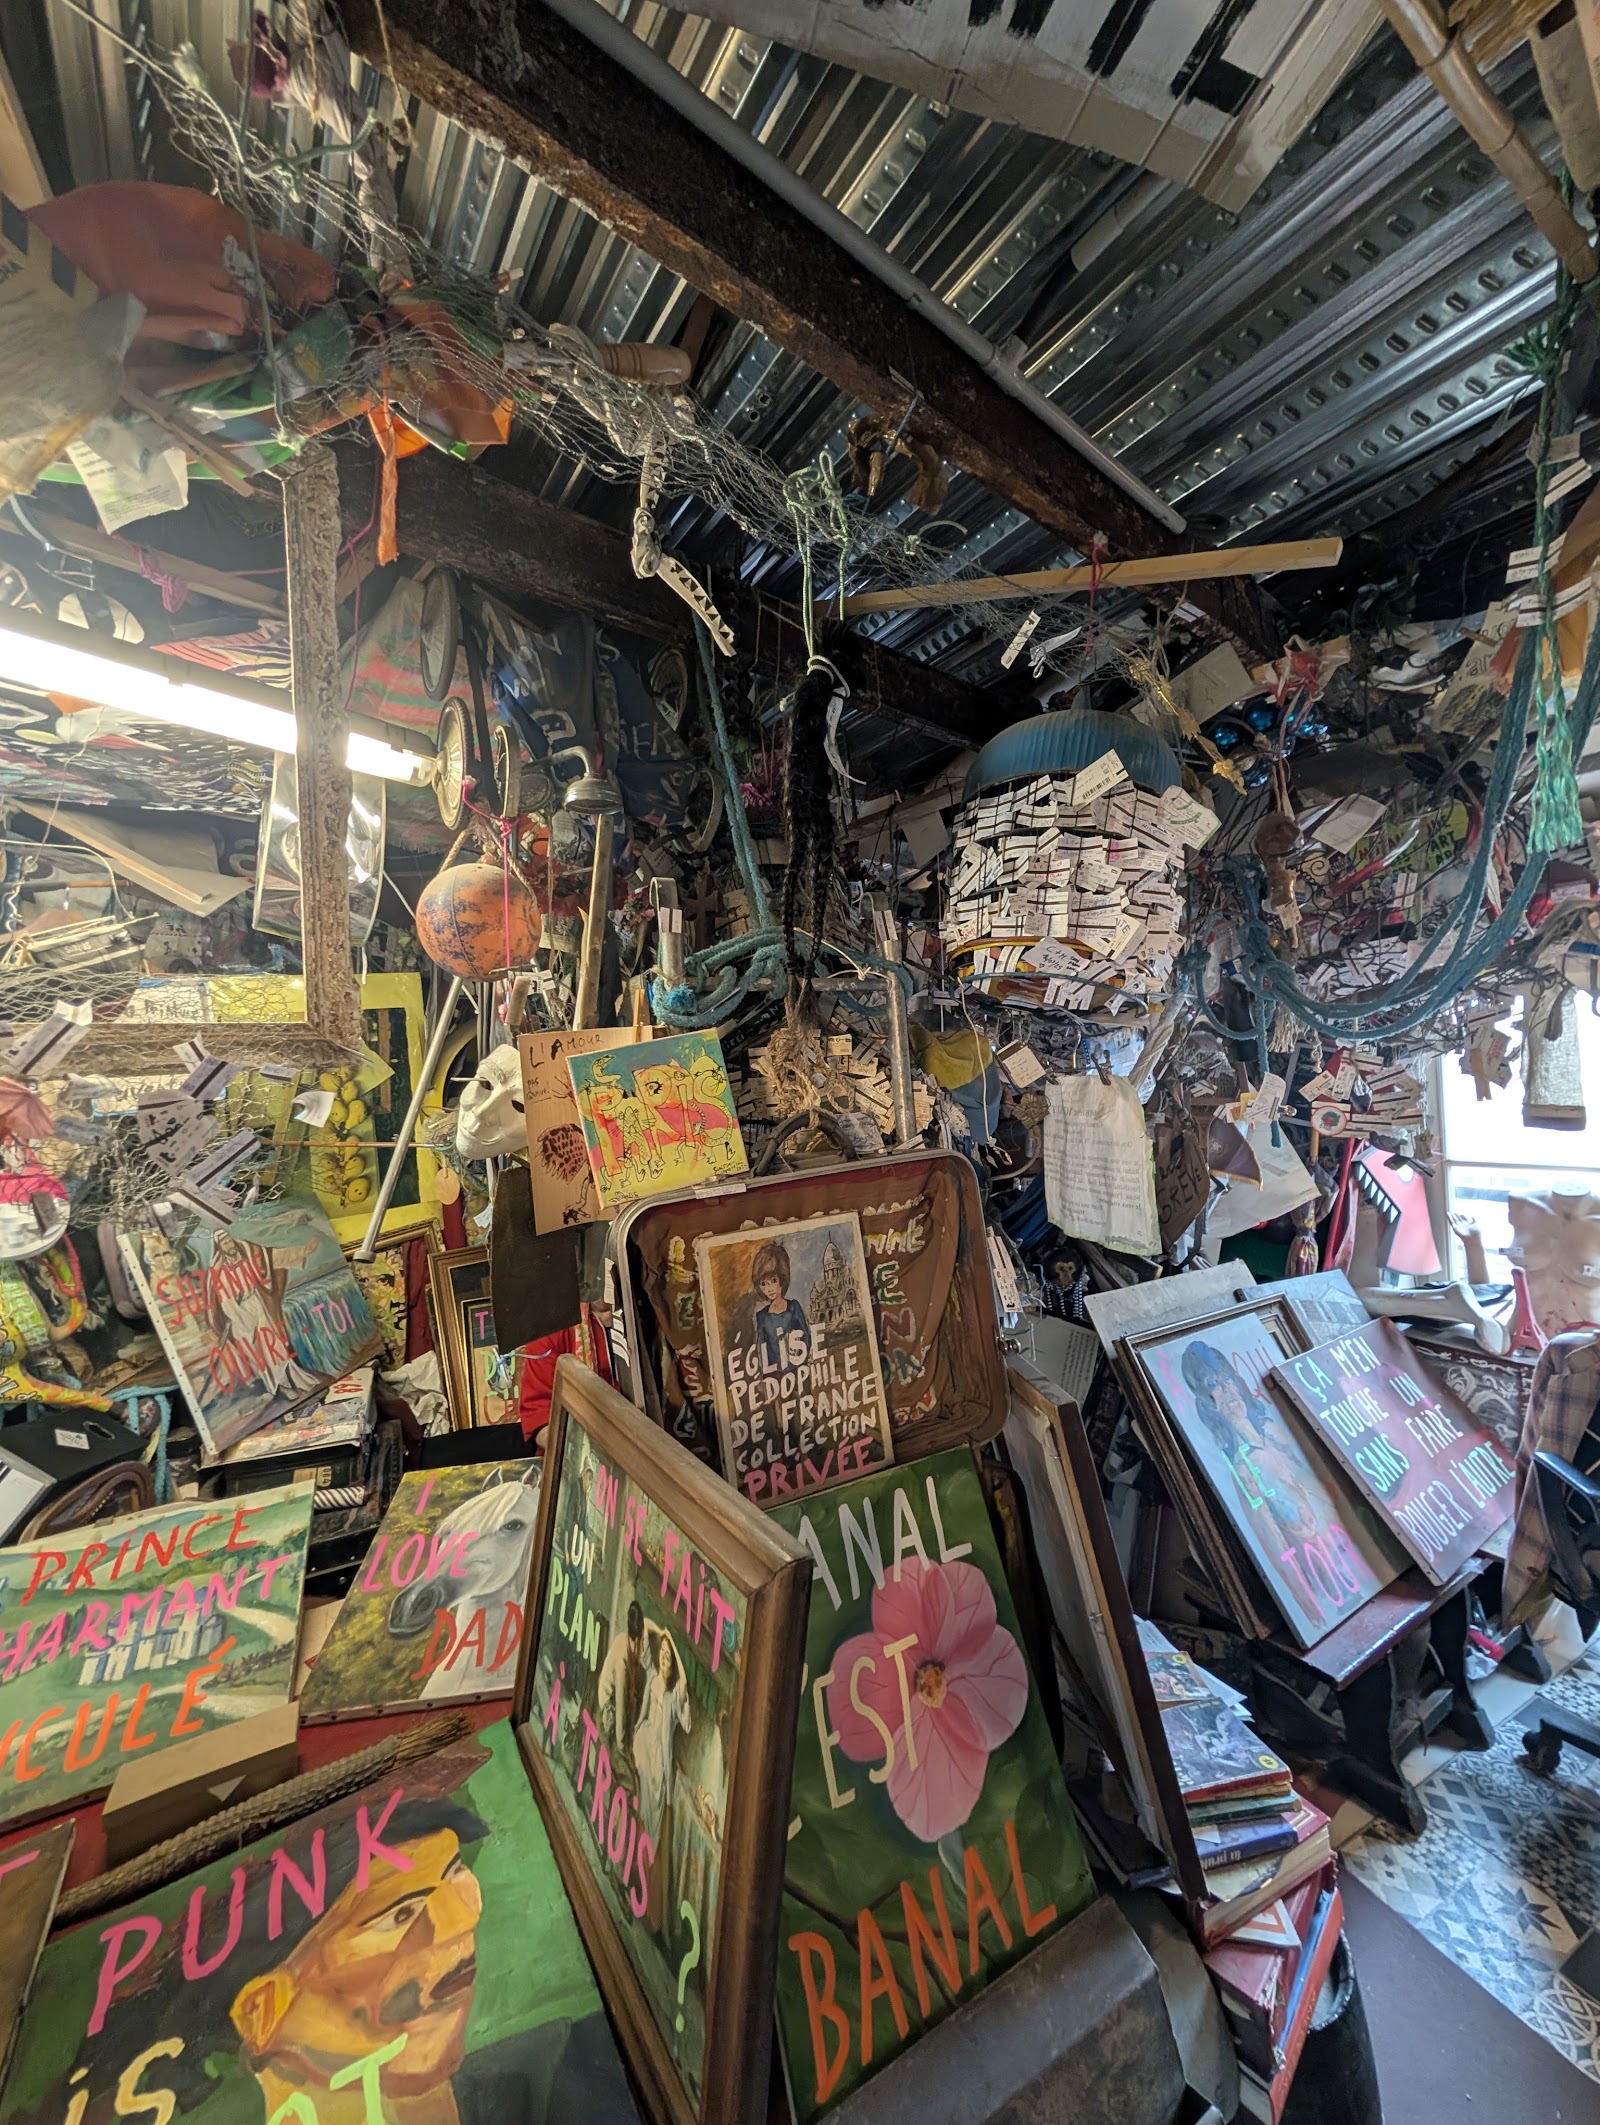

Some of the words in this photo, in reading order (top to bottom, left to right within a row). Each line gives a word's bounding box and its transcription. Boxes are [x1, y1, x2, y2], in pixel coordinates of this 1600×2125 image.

[156, 1252, 271, 1326] SUZANNE
[731, 1410, 766, 1448] DE
[781, 1372, 881, 1435] FRANCE
[1294, 1356, 1333, 1403] ÇA
[1320, 1386, 1389, 1446] TOUCHE
[1389, 1372, 1425, 1407] UN
[1221, 1443, 1276, 1510] LE
[1355, 1433, 1410, 1493] SANS
[571, 1524, 595, 1584] UN
[595, 1464, 618, 1529] ON
[625, 1495, 647, 1566] SE
[1393, 1480, 1473, 1563] BOUGER
[361, 1532, 479, 1592] LOVE
[1280, 1523, 1377, 1622] TOUR
[411, 1601, 523, 1681] DAD
[548, 1556, 601, 1672] PLAN
[87, 1789, 414, 2036] PUNK
[675, 1900, 700, 2032] ?
[788, 1821, 1057, 2104] BANAL
